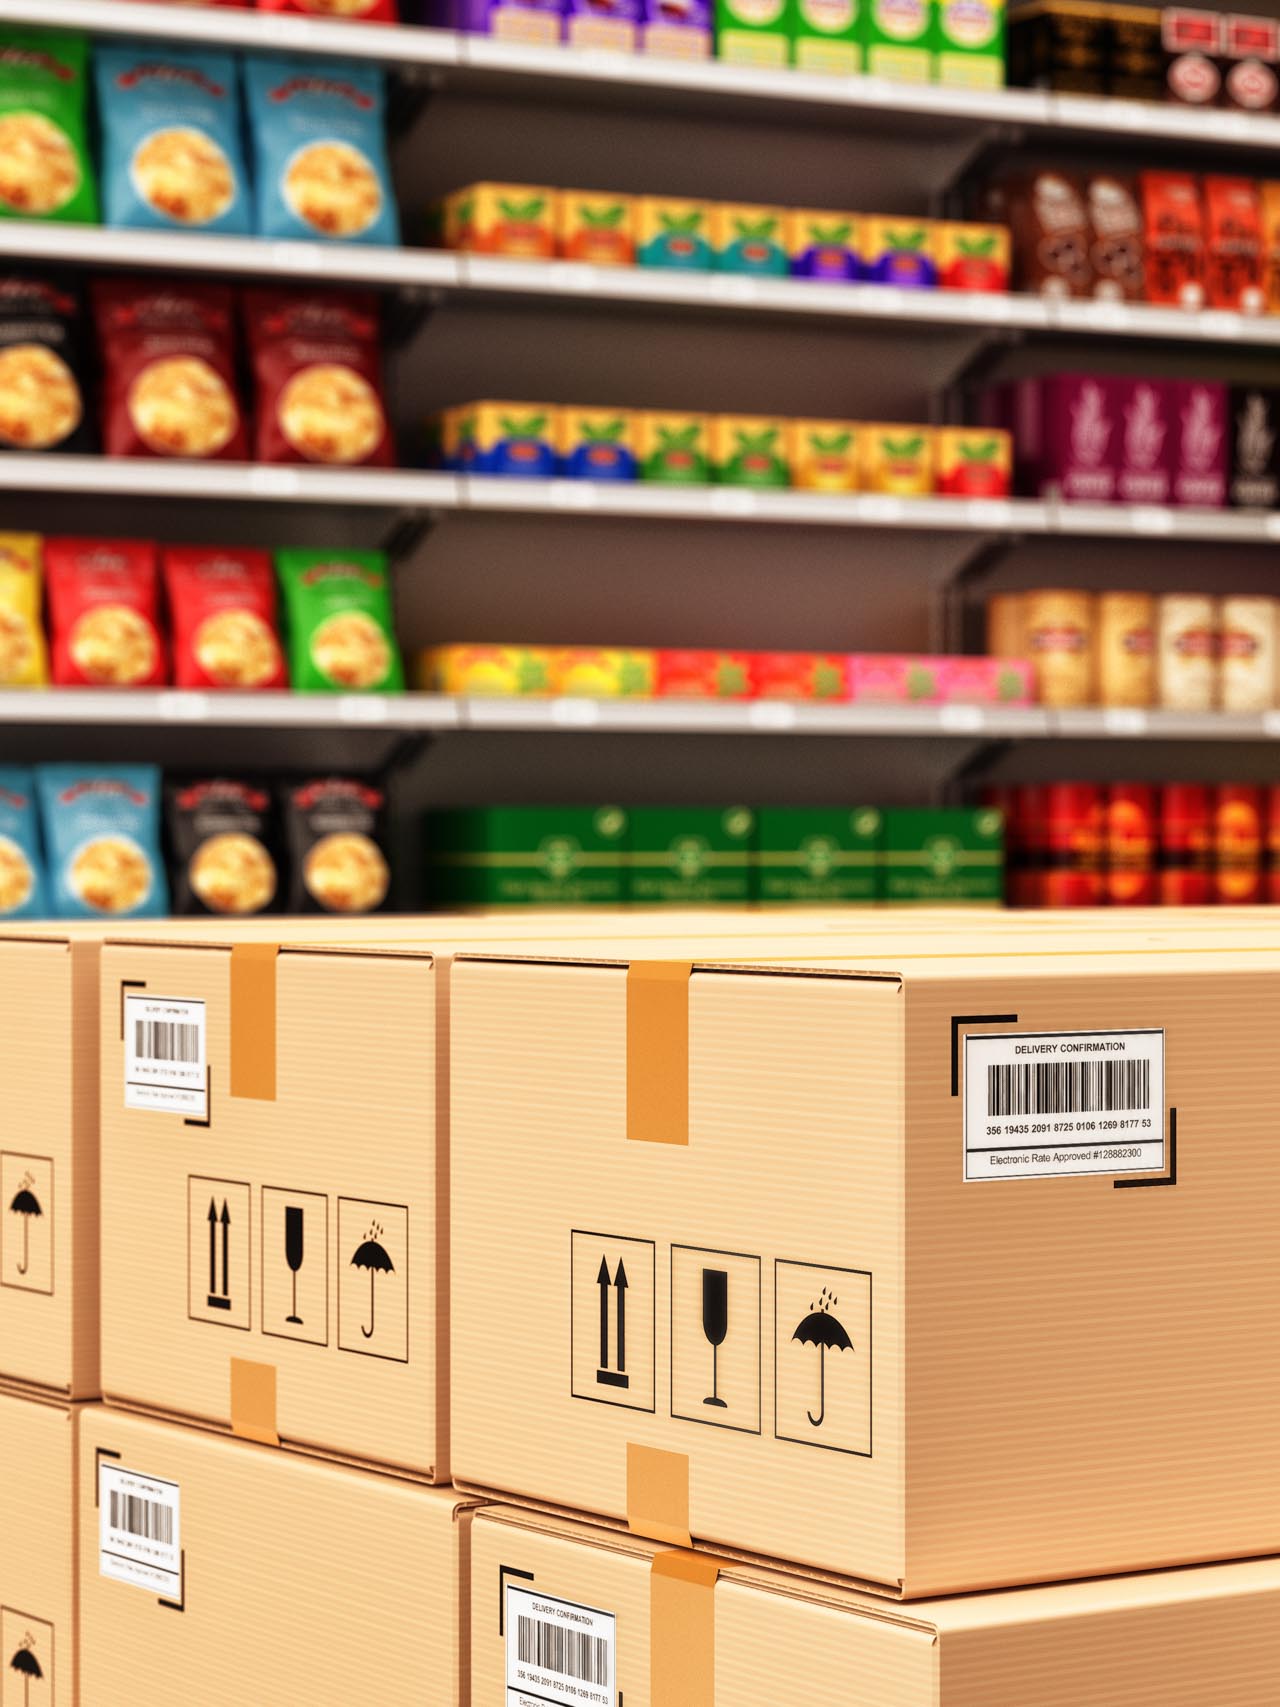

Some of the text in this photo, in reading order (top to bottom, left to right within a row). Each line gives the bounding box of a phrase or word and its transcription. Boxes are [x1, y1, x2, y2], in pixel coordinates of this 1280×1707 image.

[1015, 1042, 1125, 1054] DELIVERY CONFIRMATION
[987, 1118, 1151, 1135] 356 19435 2091 8725 0106 1269 8177 53
[990, 1148, 1141, 1165] Electronic Rate Approved #128882300
